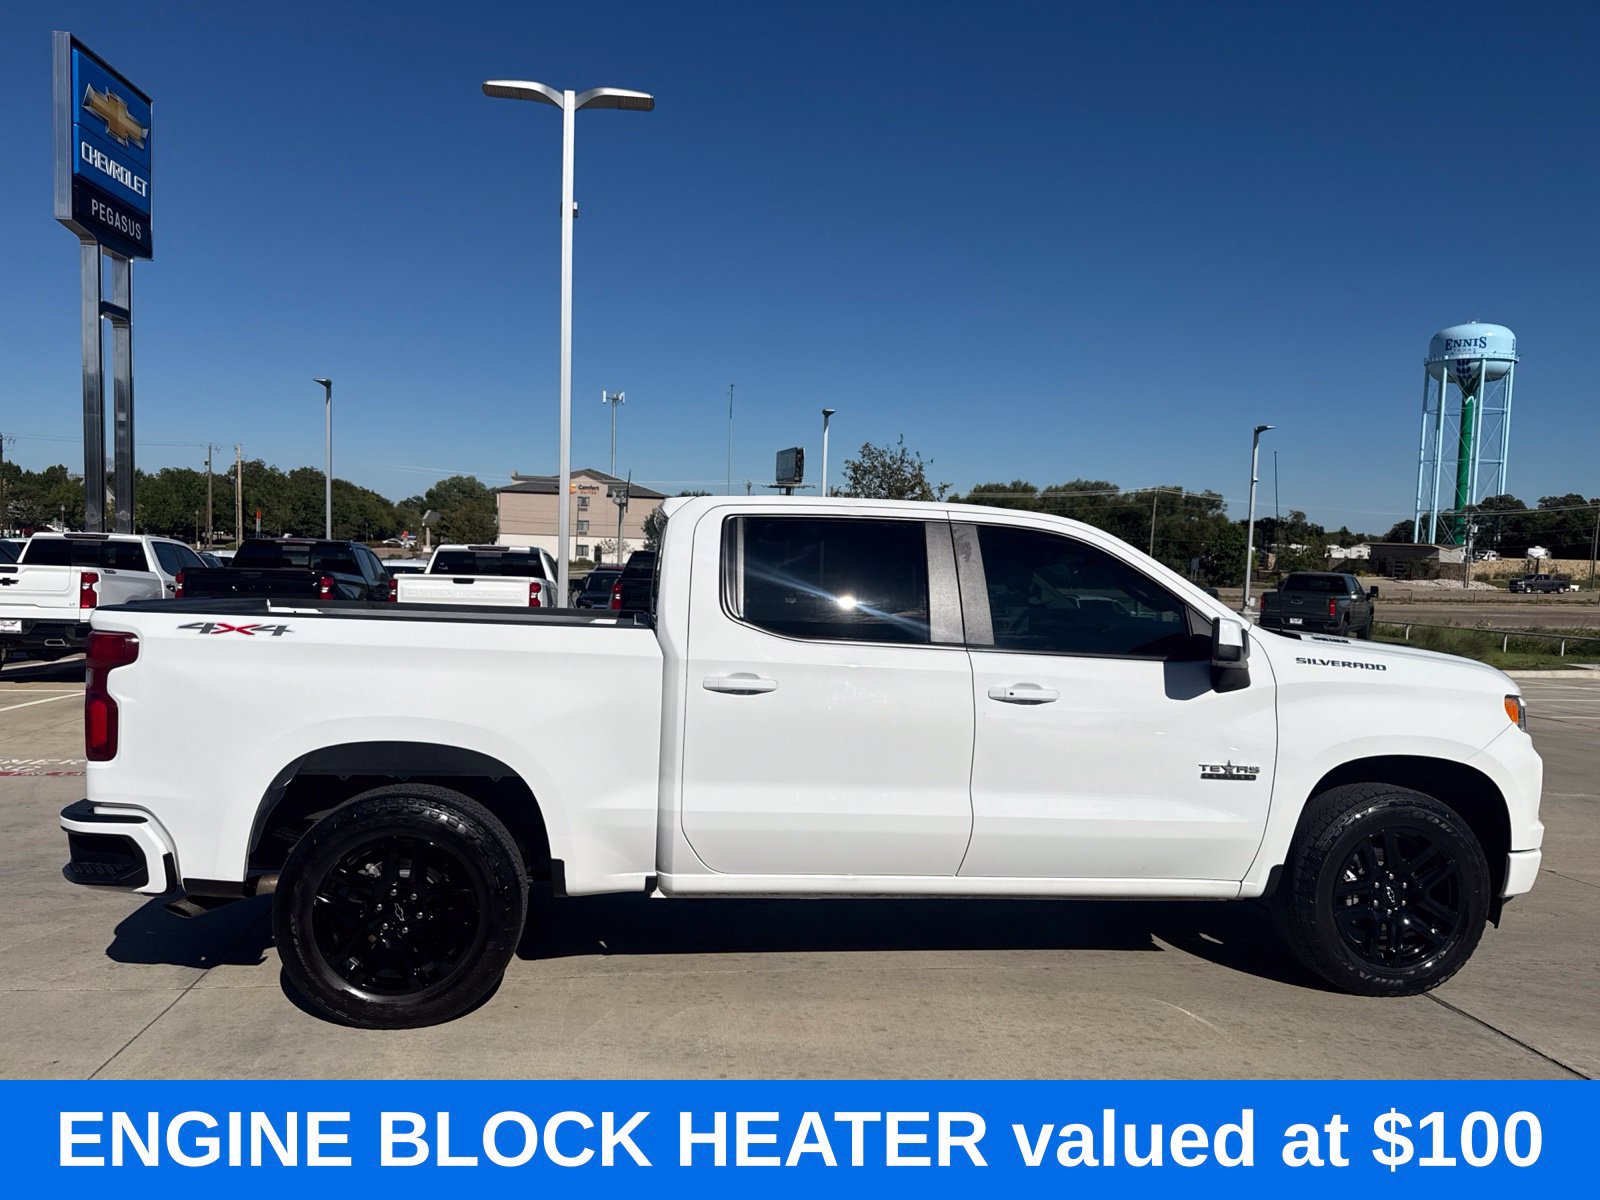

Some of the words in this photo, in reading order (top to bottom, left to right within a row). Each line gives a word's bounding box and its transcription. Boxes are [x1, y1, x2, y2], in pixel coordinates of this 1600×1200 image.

[82, 141, 149, 197] CHEVROLET
[91, 198, 142, 240] PEGASUS
[1445, 336, 1487, 351] ENNIS
[1296, 657, 1387, 671] SILVERADO
